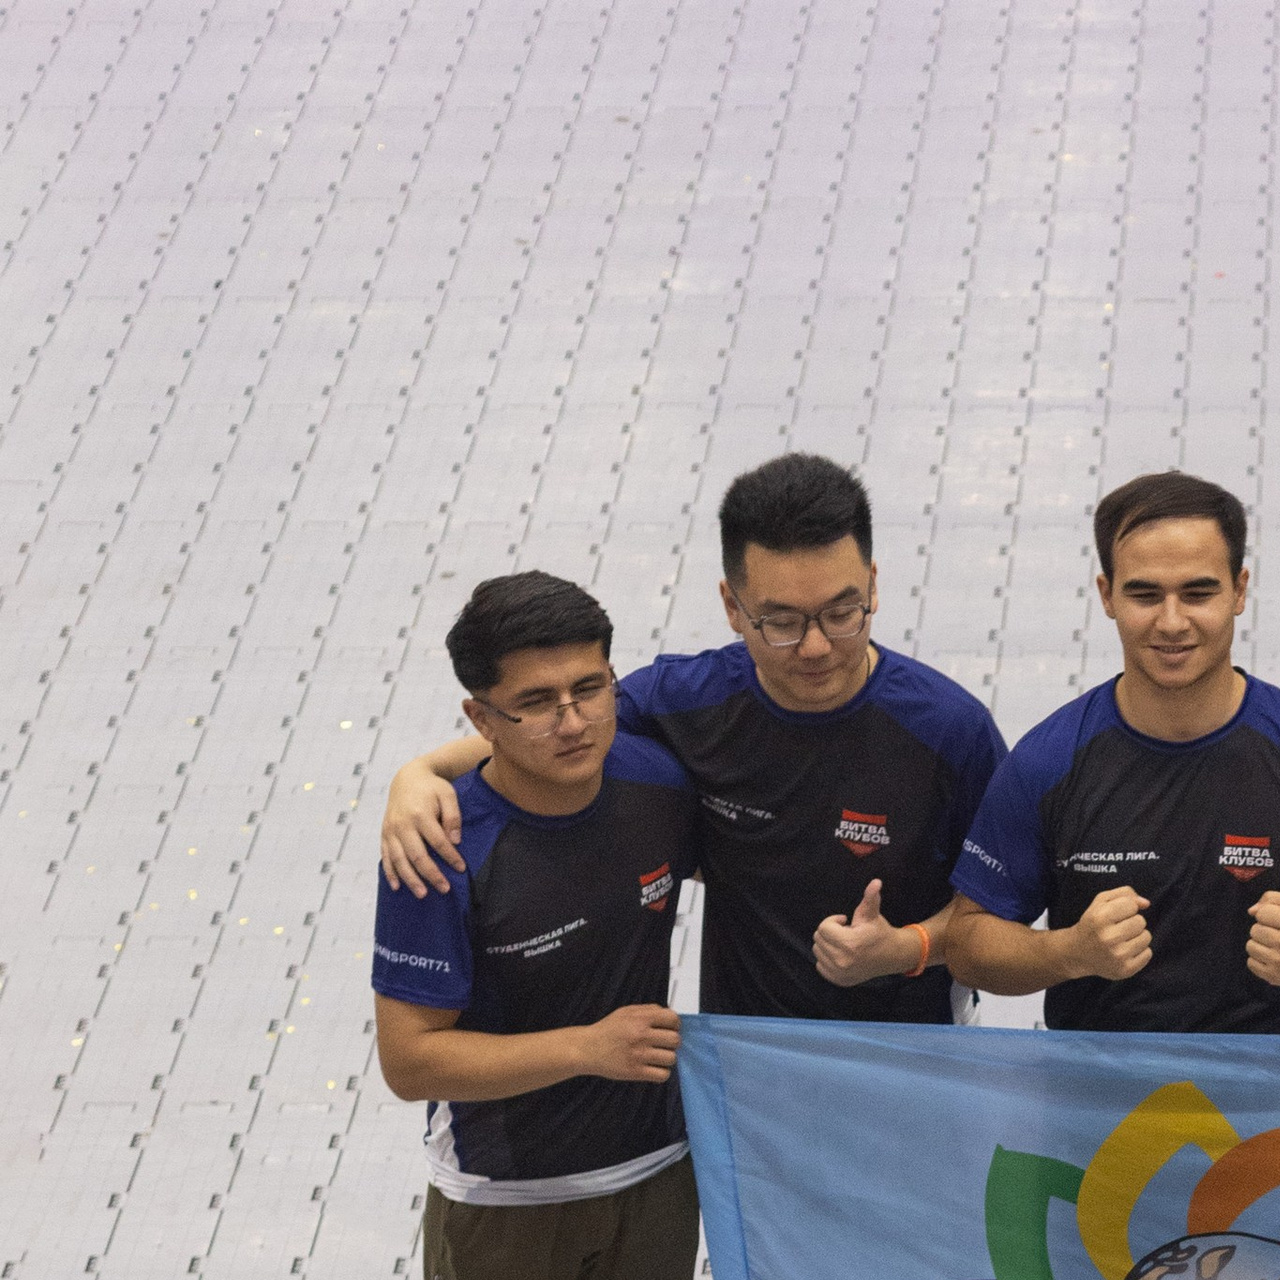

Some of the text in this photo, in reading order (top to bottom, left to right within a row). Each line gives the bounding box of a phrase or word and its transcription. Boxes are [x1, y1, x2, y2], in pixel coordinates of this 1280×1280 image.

[840, 820, 887, 835] БИТВА
[834, 828, 891, 845] КЛУБОВ
[1125, 851, 1160, 861] ЛИГА.
[1223, 846, 1270, 858] БИТВА
[1218, 855, 1274, 867] КЛУБОВ
[1073, 863, 1118, 873] ВЫШКА
